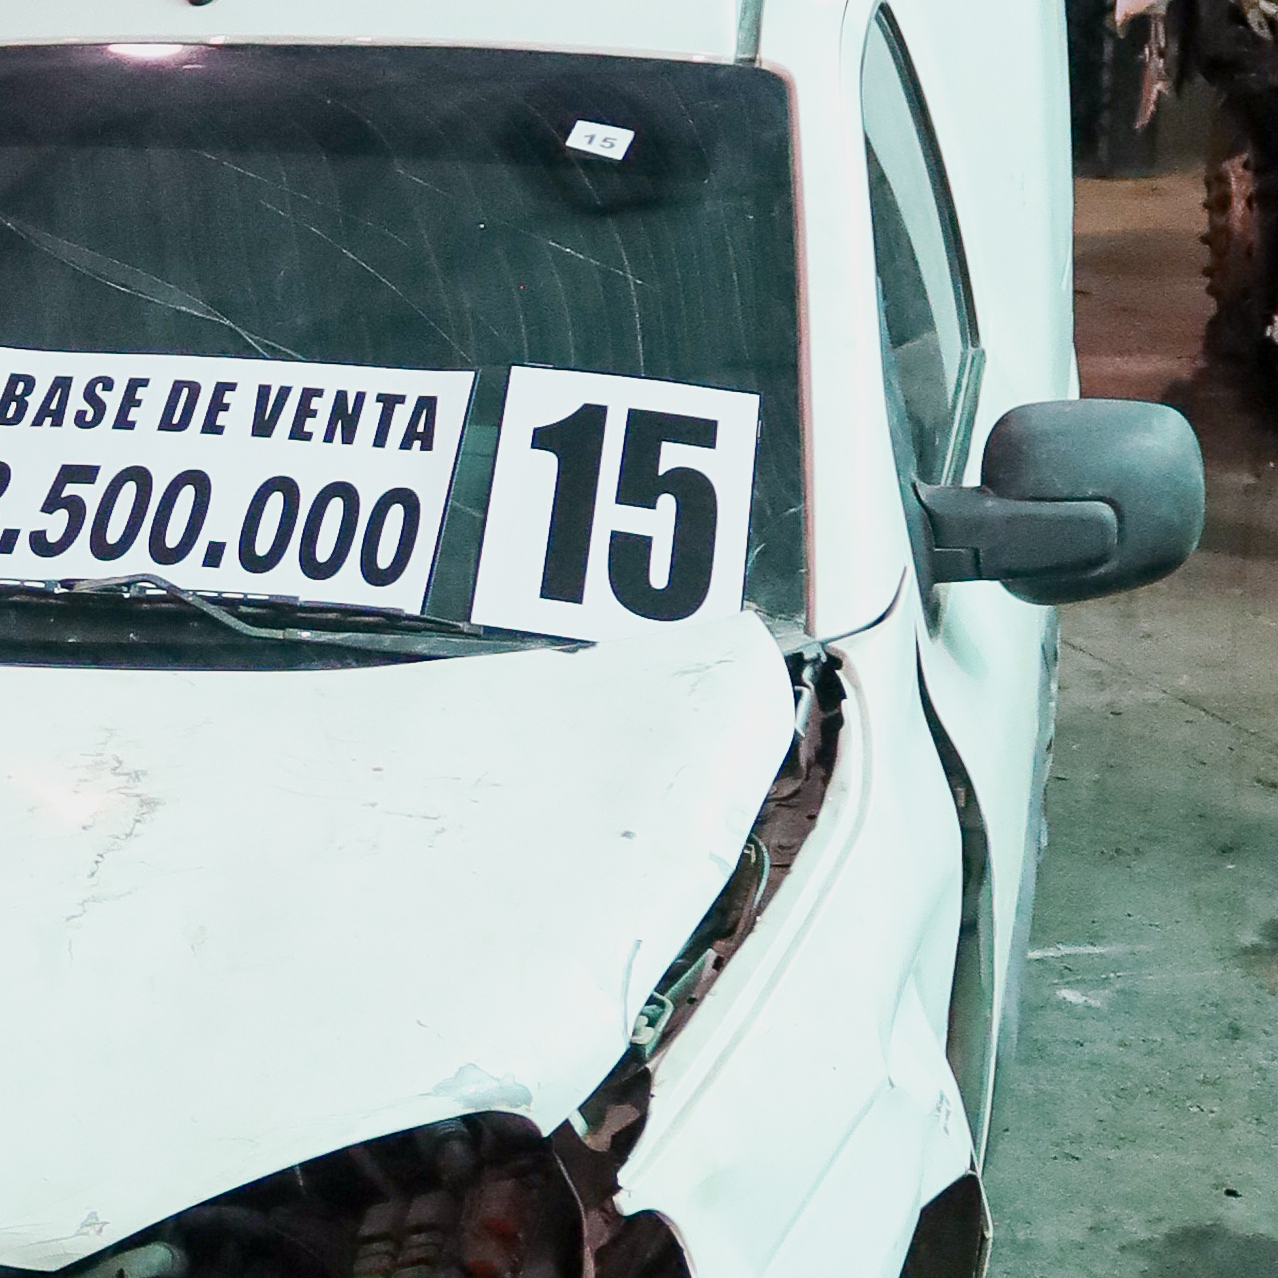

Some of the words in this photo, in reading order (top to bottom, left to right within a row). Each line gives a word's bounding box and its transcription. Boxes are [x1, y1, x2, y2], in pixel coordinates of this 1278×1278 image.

[583, 133, 618, 150] 15
[156, 379, 238, 436] DE
[250, 384, 438, 452] VENTA
[530, 403, 718, 622] 15
